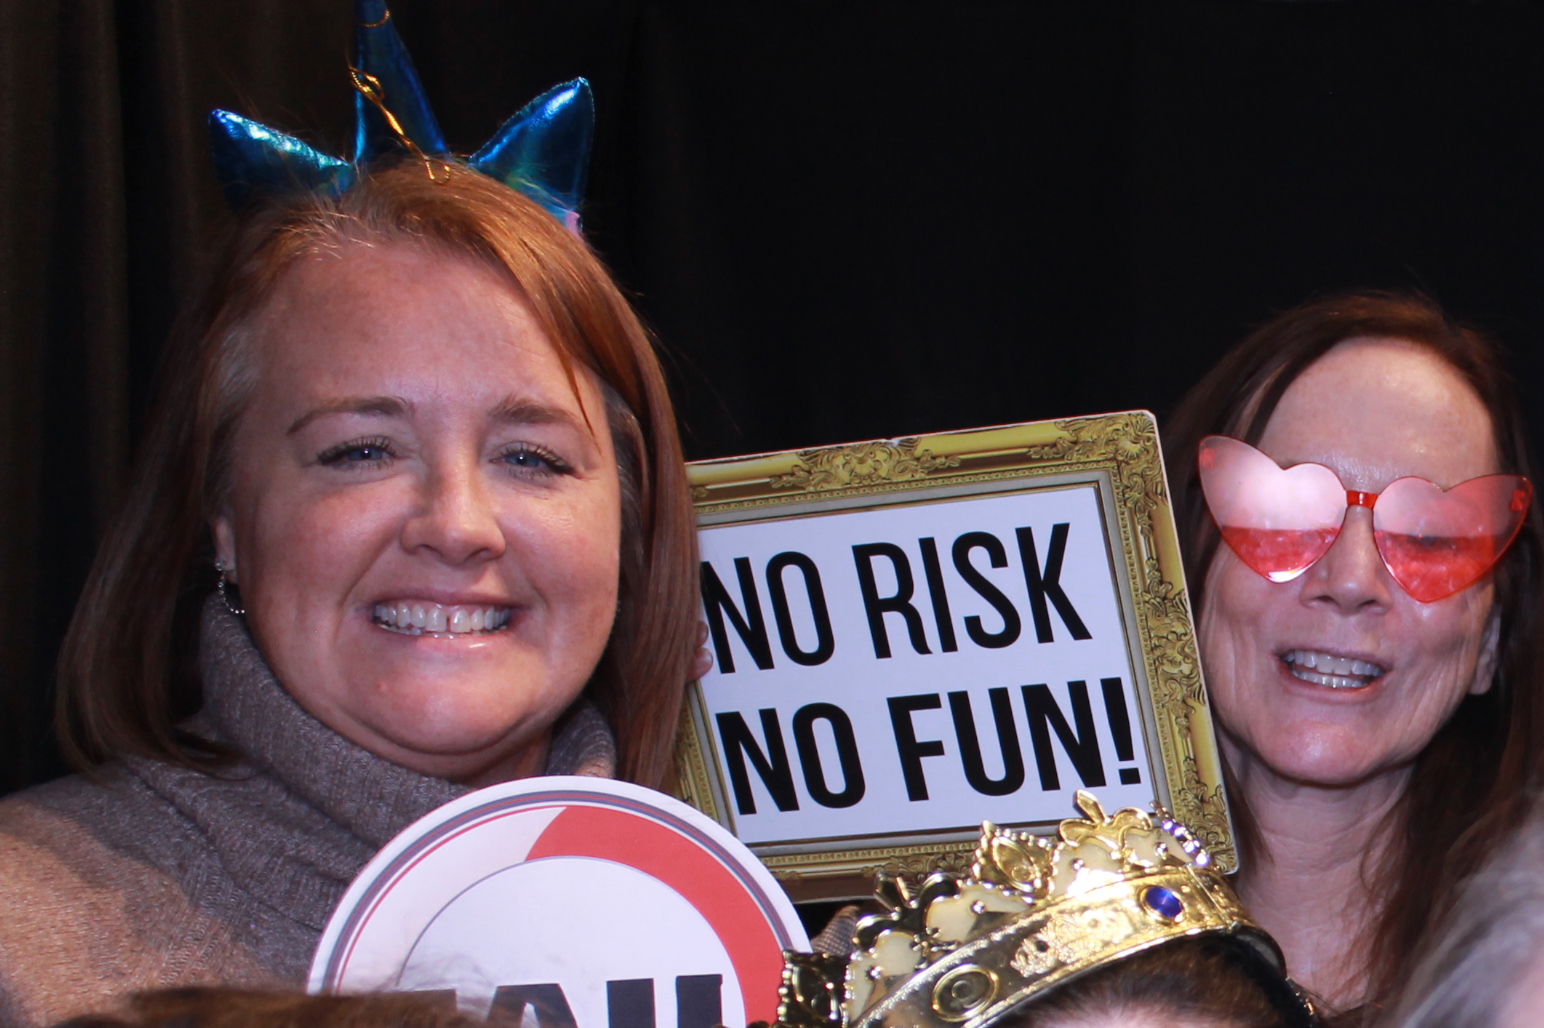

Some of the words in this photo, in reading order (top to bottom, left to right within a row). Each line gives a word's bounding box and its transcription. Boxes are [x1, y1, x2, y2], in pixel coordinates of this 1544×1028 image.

[700, 551, 835, 674] NO
[851, 522, 1093, 659] RISK
[715, 701, 866, 815] NO
[886, 677, 1142, 802] FUN!
